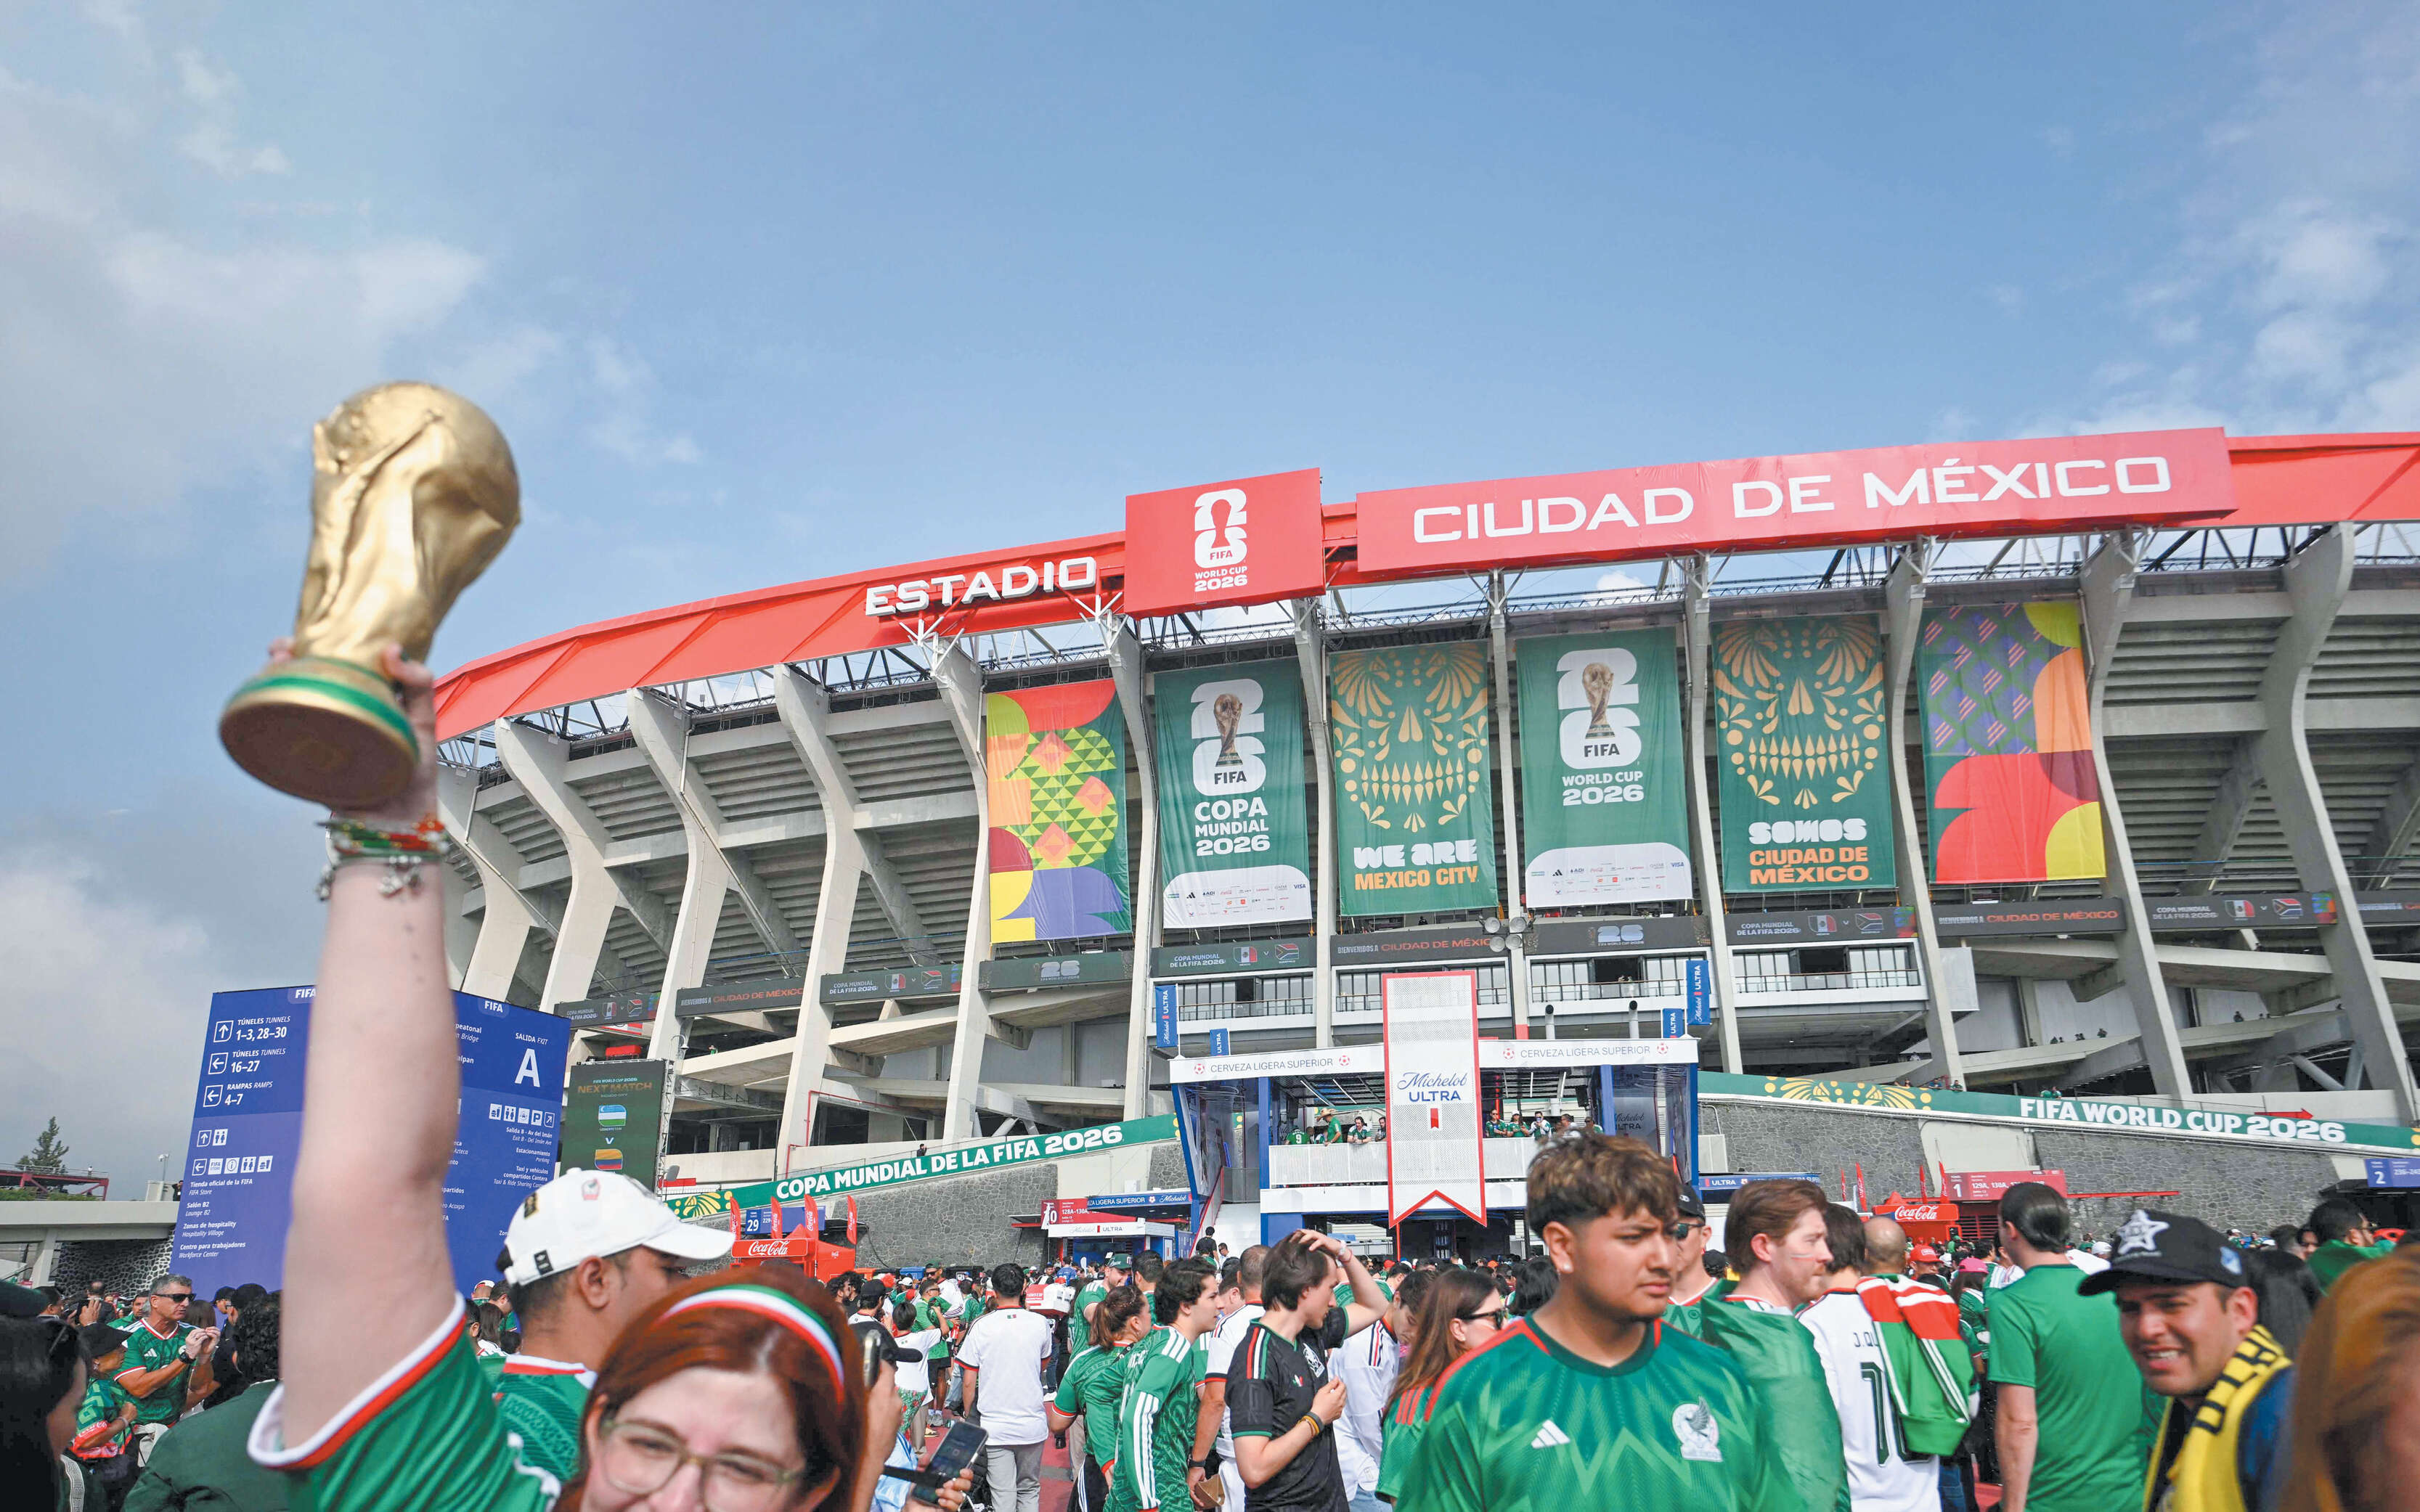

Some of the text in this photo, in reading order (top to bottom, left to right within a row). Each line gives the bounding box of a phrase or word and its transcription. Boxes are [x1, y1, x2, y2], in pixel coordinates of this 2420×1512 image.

[1413, 456, 2172, 544] CIUDAD DE MÉXICO
[1209, 549, 1233, 560] FIFA
[1194, 565, 1248, 580] WORLD CUP
[865, 556, 1096, 616] ESTADIO
[1194, 574, 1248, 592] 2026
[1584, 743, 1620, 758] FIFA
[1214, 771, 1247, 785] FIFA
[1562, 771, 1643, 787] WORLD CUP
[1563, 785, 1645, 806] 2026
[1194, 797, 1268, 822] COPA
[1194, 818, 1269, 838] MUNDIAL
[1748, 818, 1867, 845] SOMOS
[1196, 834, 1271, 857] 2026
[1353, 839, 1478, 869] WE ARE
[1749, 846, 1868, 866] CIUDAD DE
[1355, 866, 1478, 890] MEXICO CITY
[1750, 864, 1869, 884] MÉXICO
[1987, 913, 2040, 923] CIUDAD
[2042, 912, 2061, 921] DE
[2063, 910, 2118, 920] MÉXICO
[1337, 945, 1374, 954] BIENVENIDOS
[1381, 942, 1430, 952] CIUDAD
[1432, 940, 1449, 949] DE
[1452, 937, 1491, 947] MÉXIC
[712, 994, 751, 1003] CIUDAD
[484, 1000, 503, 1013] FIFA
[455, 1023, 482, 1034] peatonal
[461, 1033, 479, 1043] Bridge
[515, 1032, 536, 1043] SALIDA
[261, 1047, 286, 1056] TUNNELS
[1520, 1045, 1650, 1058] CERVEZA LIGERA SUPERIOR
[515, 1048, 540, 1087] A
[1210, 1058, 1333, 1073] CERVEZA LIGERA SUPERIOR
[577, 1082, 653, 1093] NEXT MATCH
[1397, 1072, 1467, 1090] Michelob
[1409, 1090, 1461, 1102] ULTRA
[2020, 1098, 2346, 1143] FIFA WORLD CUP 2026
[1295, 1134, 1302, 1144] 9
[516, 1147, 550, 1156] Estacionamiento
[776, 1125, 1123, 1199] COPA MUNDIAL DE LA FIFA 2026
[2374, 1171, 2387, 1184] 2
[1953, 1184, 1963, 1197] 1
[1160, 1194, 1186, 1203] Michelob
[746, 1219, 759, 1232] 29
[748, 1241, 790, 1256] Coca-Cola
